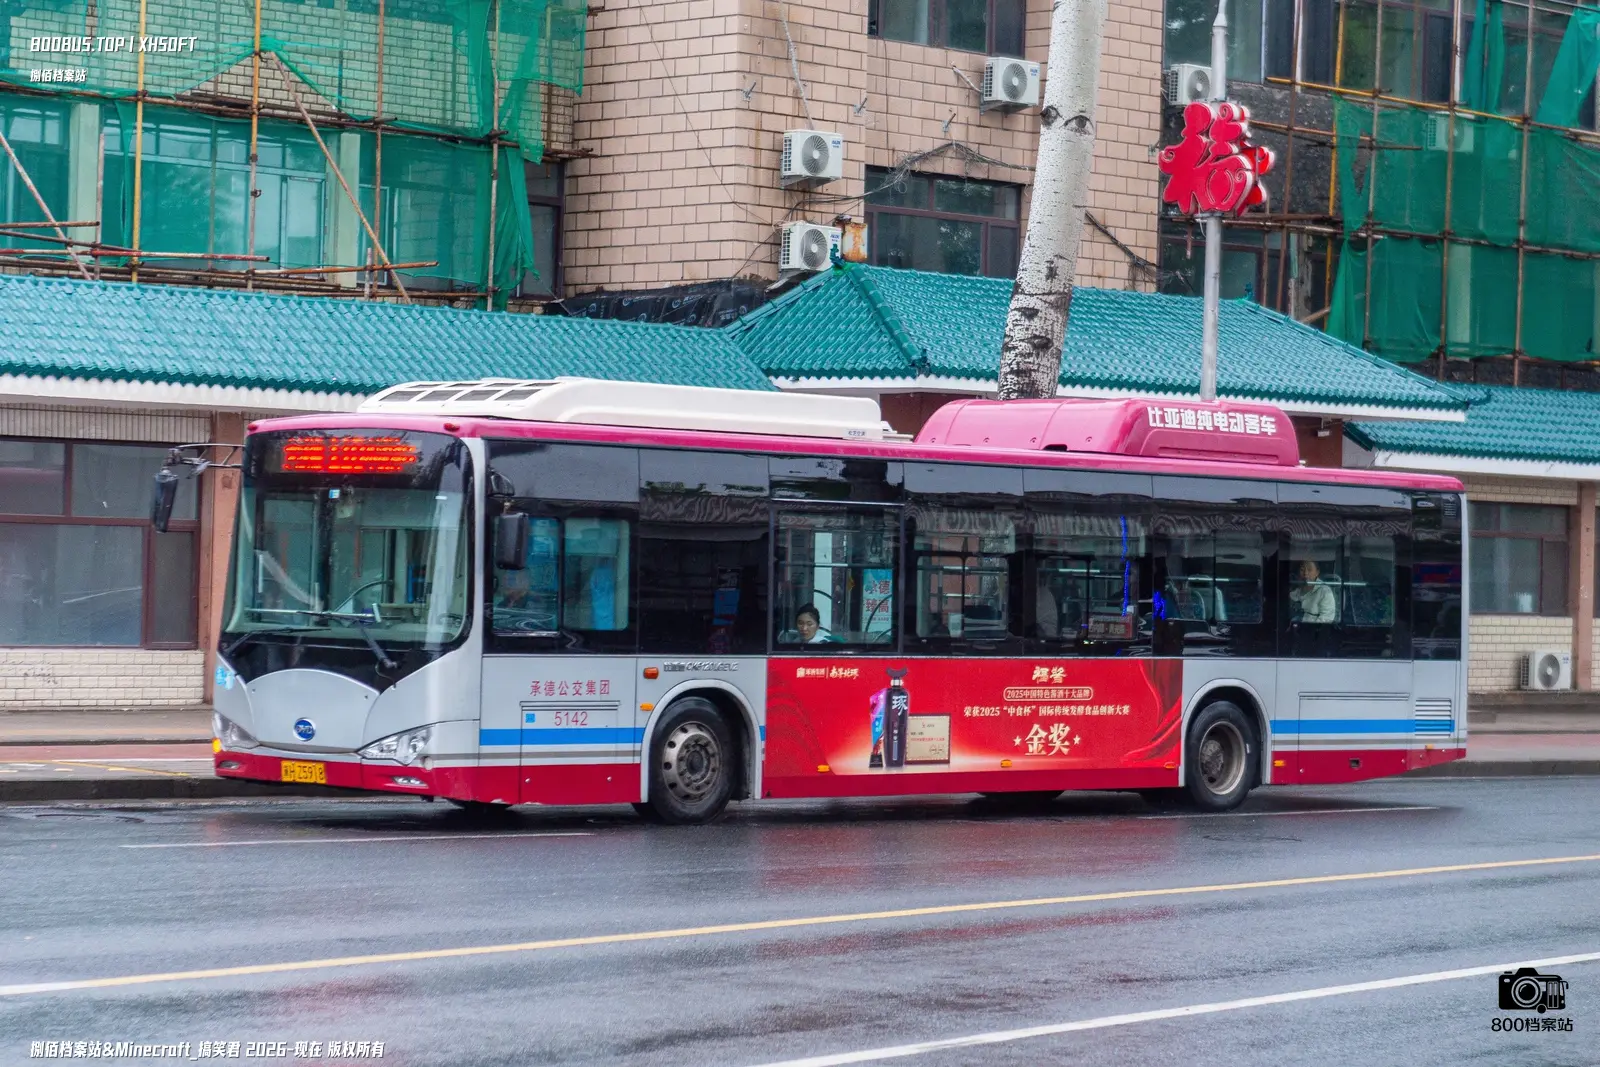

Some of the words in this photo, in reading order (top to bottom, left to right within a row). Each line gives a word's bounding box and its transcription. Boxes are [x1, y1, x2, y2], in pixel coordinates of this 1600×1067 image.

[1146, 406, 1277, 435] 比亚迪纯电动客车
[530, 679, 610, 697] 承德公交集团
[554, 711, 589, 727] 5142
[1024, 722, 1071, 757] 金奖
